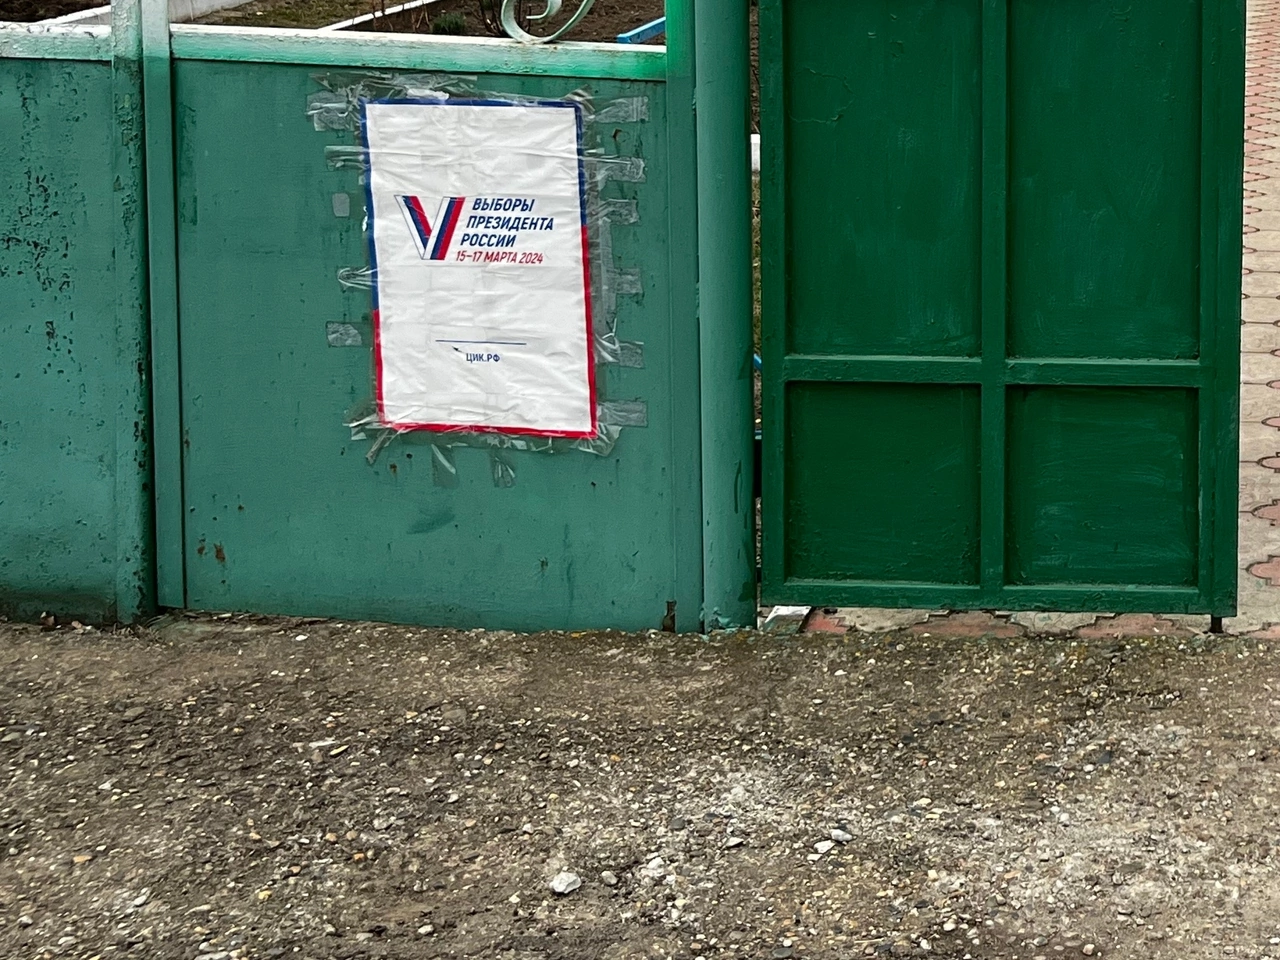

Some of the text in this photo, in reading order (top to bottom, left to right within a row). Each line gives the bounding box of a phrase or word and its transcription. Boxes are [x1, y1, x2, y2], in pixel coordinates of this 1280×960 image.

[472, 198, 535, 212] ВЫБОРЫ
[466, 216, 554, 232] ПРЕЗИДЕНТА
[460, 234, 516, 248] РОССИИ
[483, 251, 518, 264] МАРТА
[519, 252, 544, 264] 2024
[466, 352, 501, 364] ЦИК.РФ
